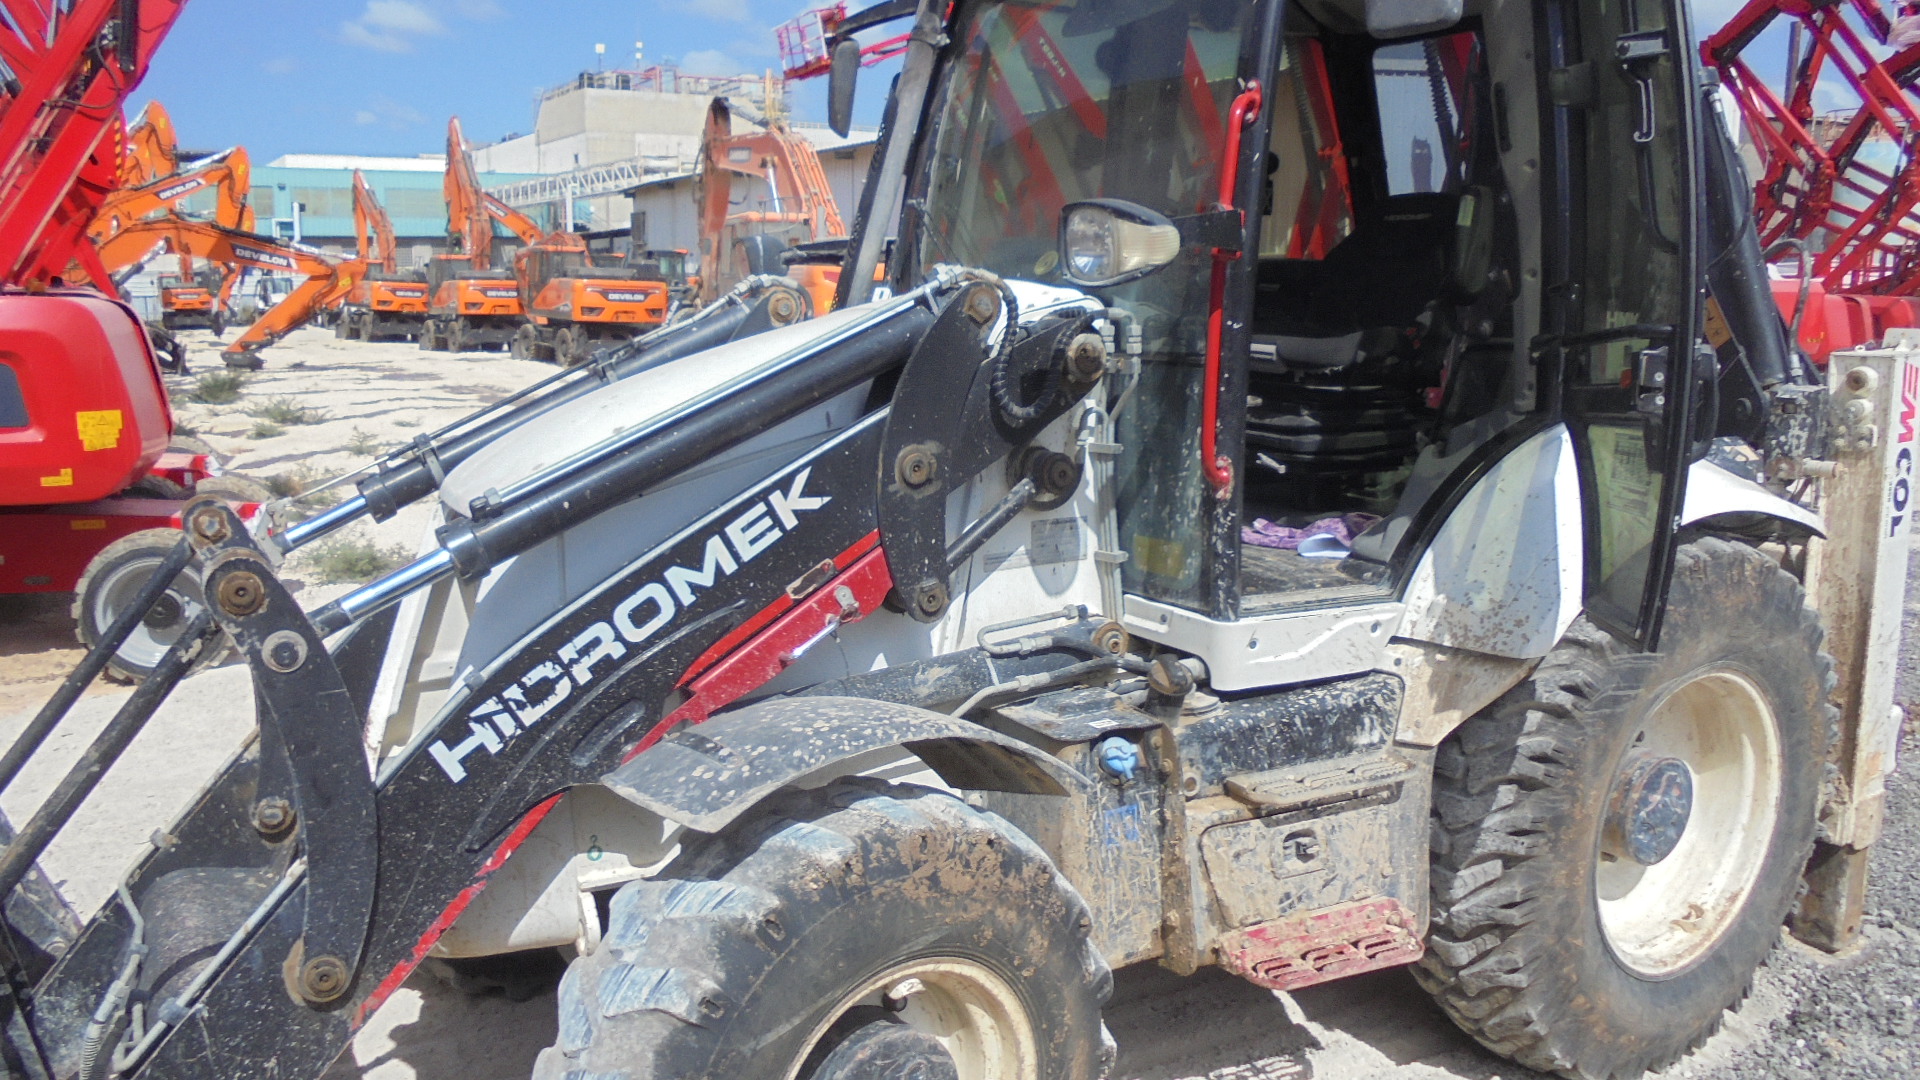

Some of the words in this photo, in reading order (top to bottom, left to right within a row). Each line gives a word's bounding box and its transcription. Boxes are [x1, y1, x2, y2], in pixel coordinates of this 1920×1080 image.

[159, 180, 198, 200] DEVELON
[235, 248, 288, 267] DEVELON
[608, 293, 645, 301] DEVELON
